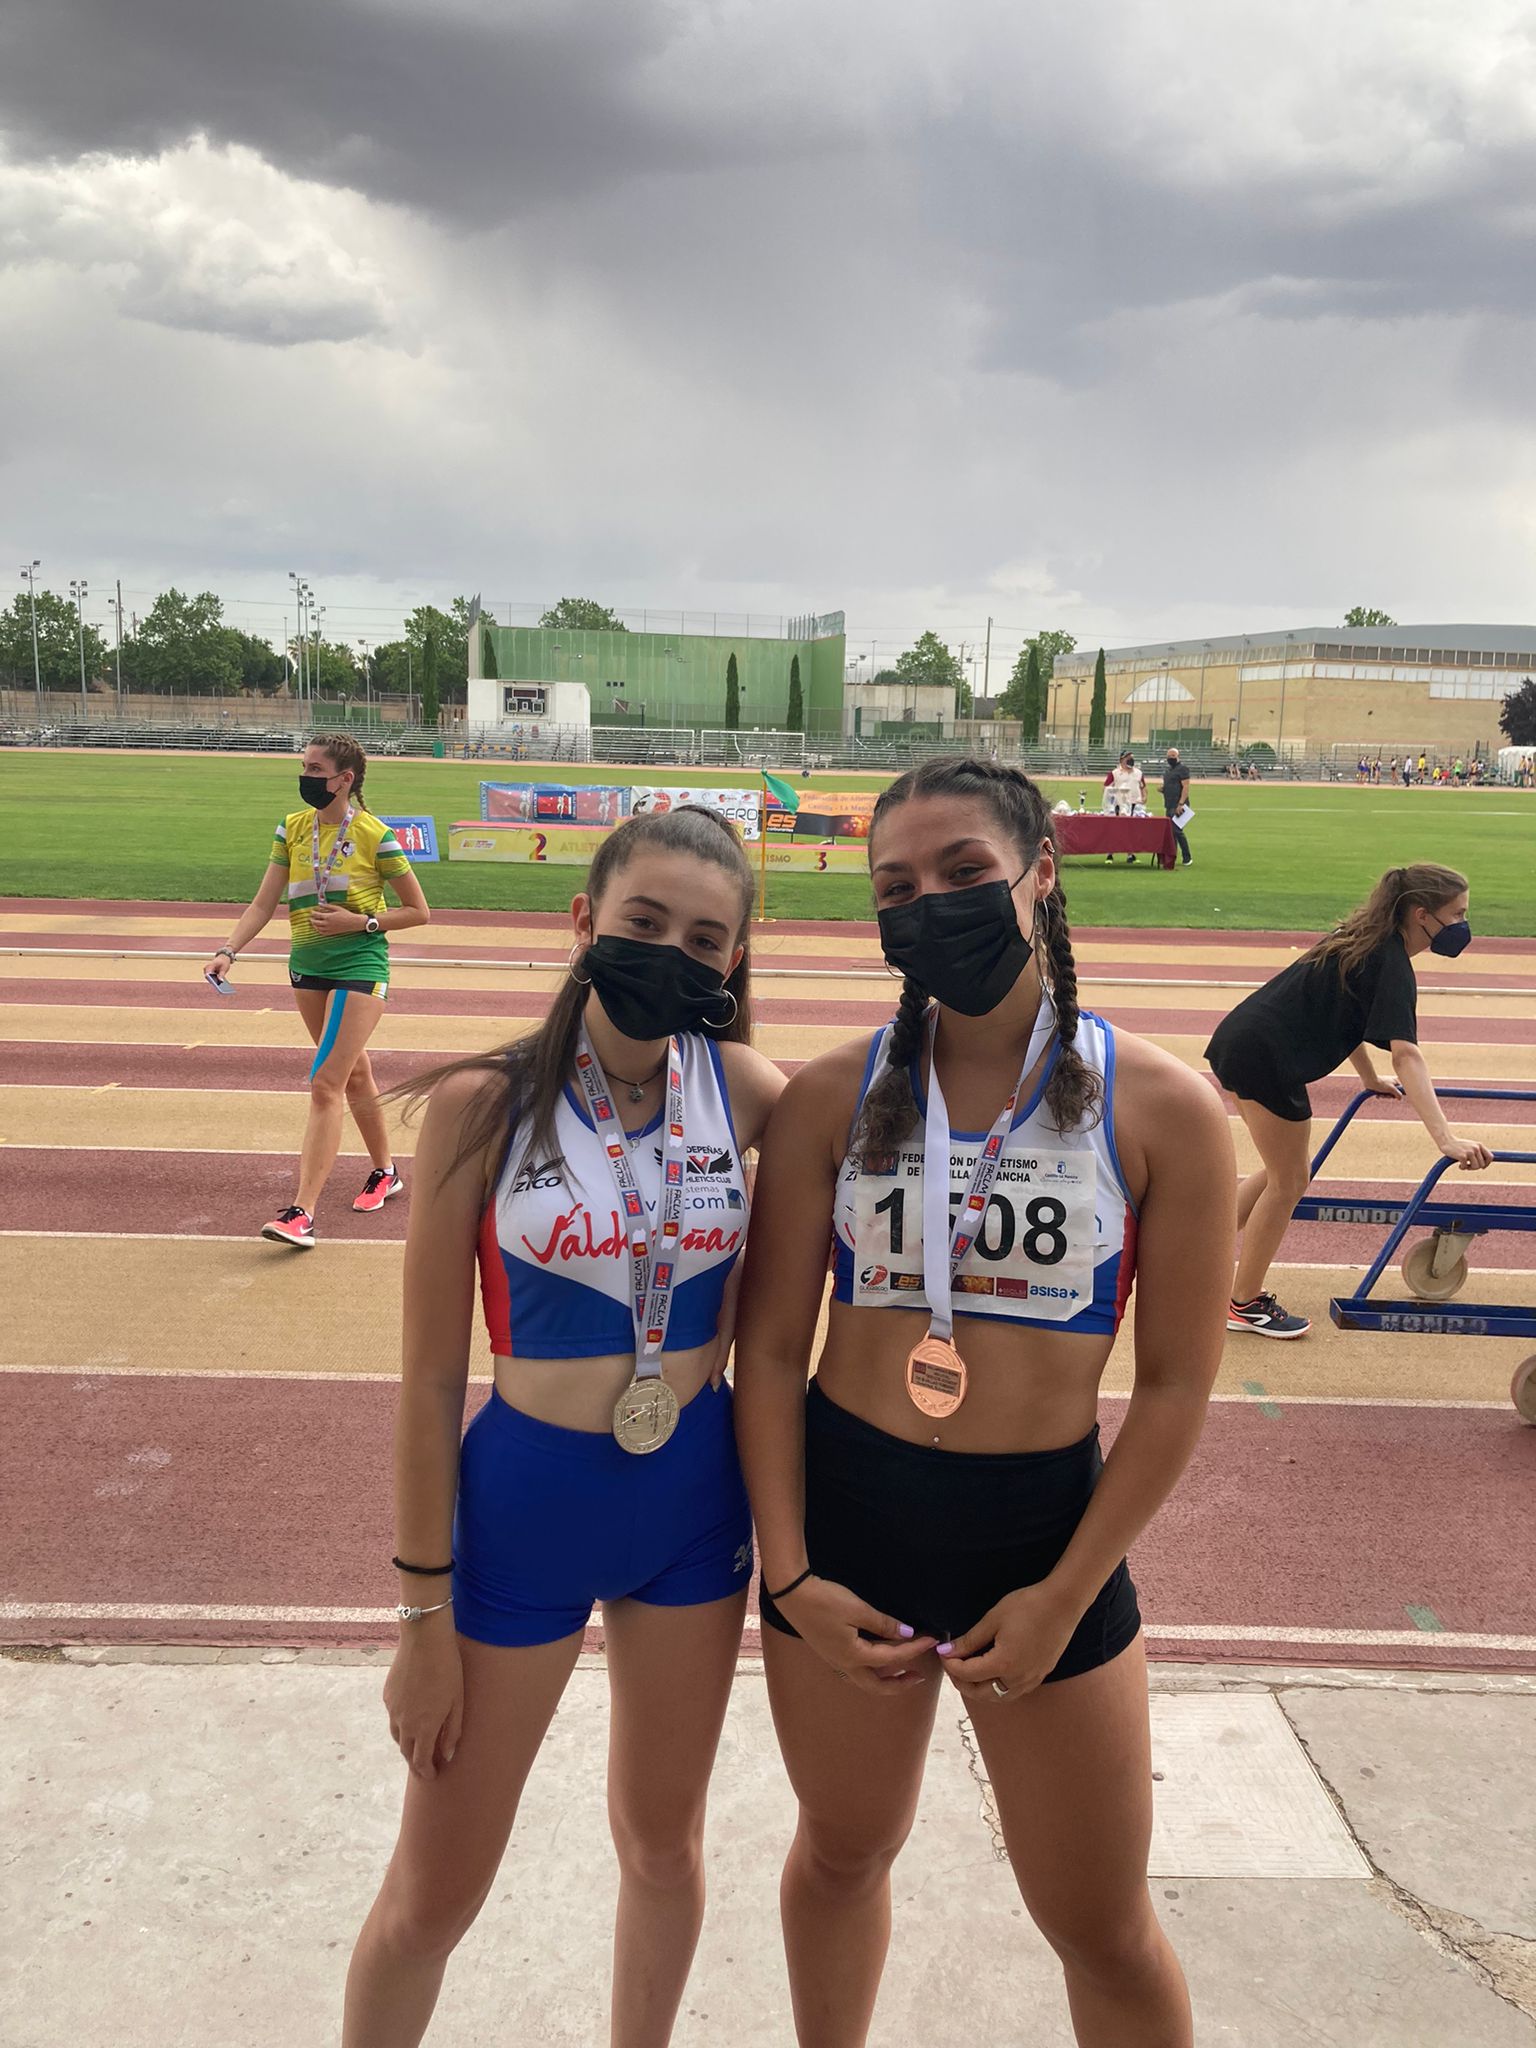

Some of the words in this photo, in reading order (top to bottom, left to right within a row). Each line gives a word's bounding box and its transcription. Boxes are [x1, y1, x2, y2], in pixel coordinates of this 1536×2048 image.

[529, 833, 547, 860] 2
[815, 852, 827, 870] 3
[907, 1166, 921, 1177] DE
[995, 1171, 1031, 1183] ANCHA
[978, 1163, 995, 1195] FACLM
[513, 1176, 563, 1193] ZICO
[671, 1189, 682, 1220] FACLM
[1318, 1207, 1402, 1225] MONDO
[1029, 1285, 1068, 1299] asisa
[655, 1294, 668, 1327] FACLM
[1380, 1315, 1488, 1334] MONDO
